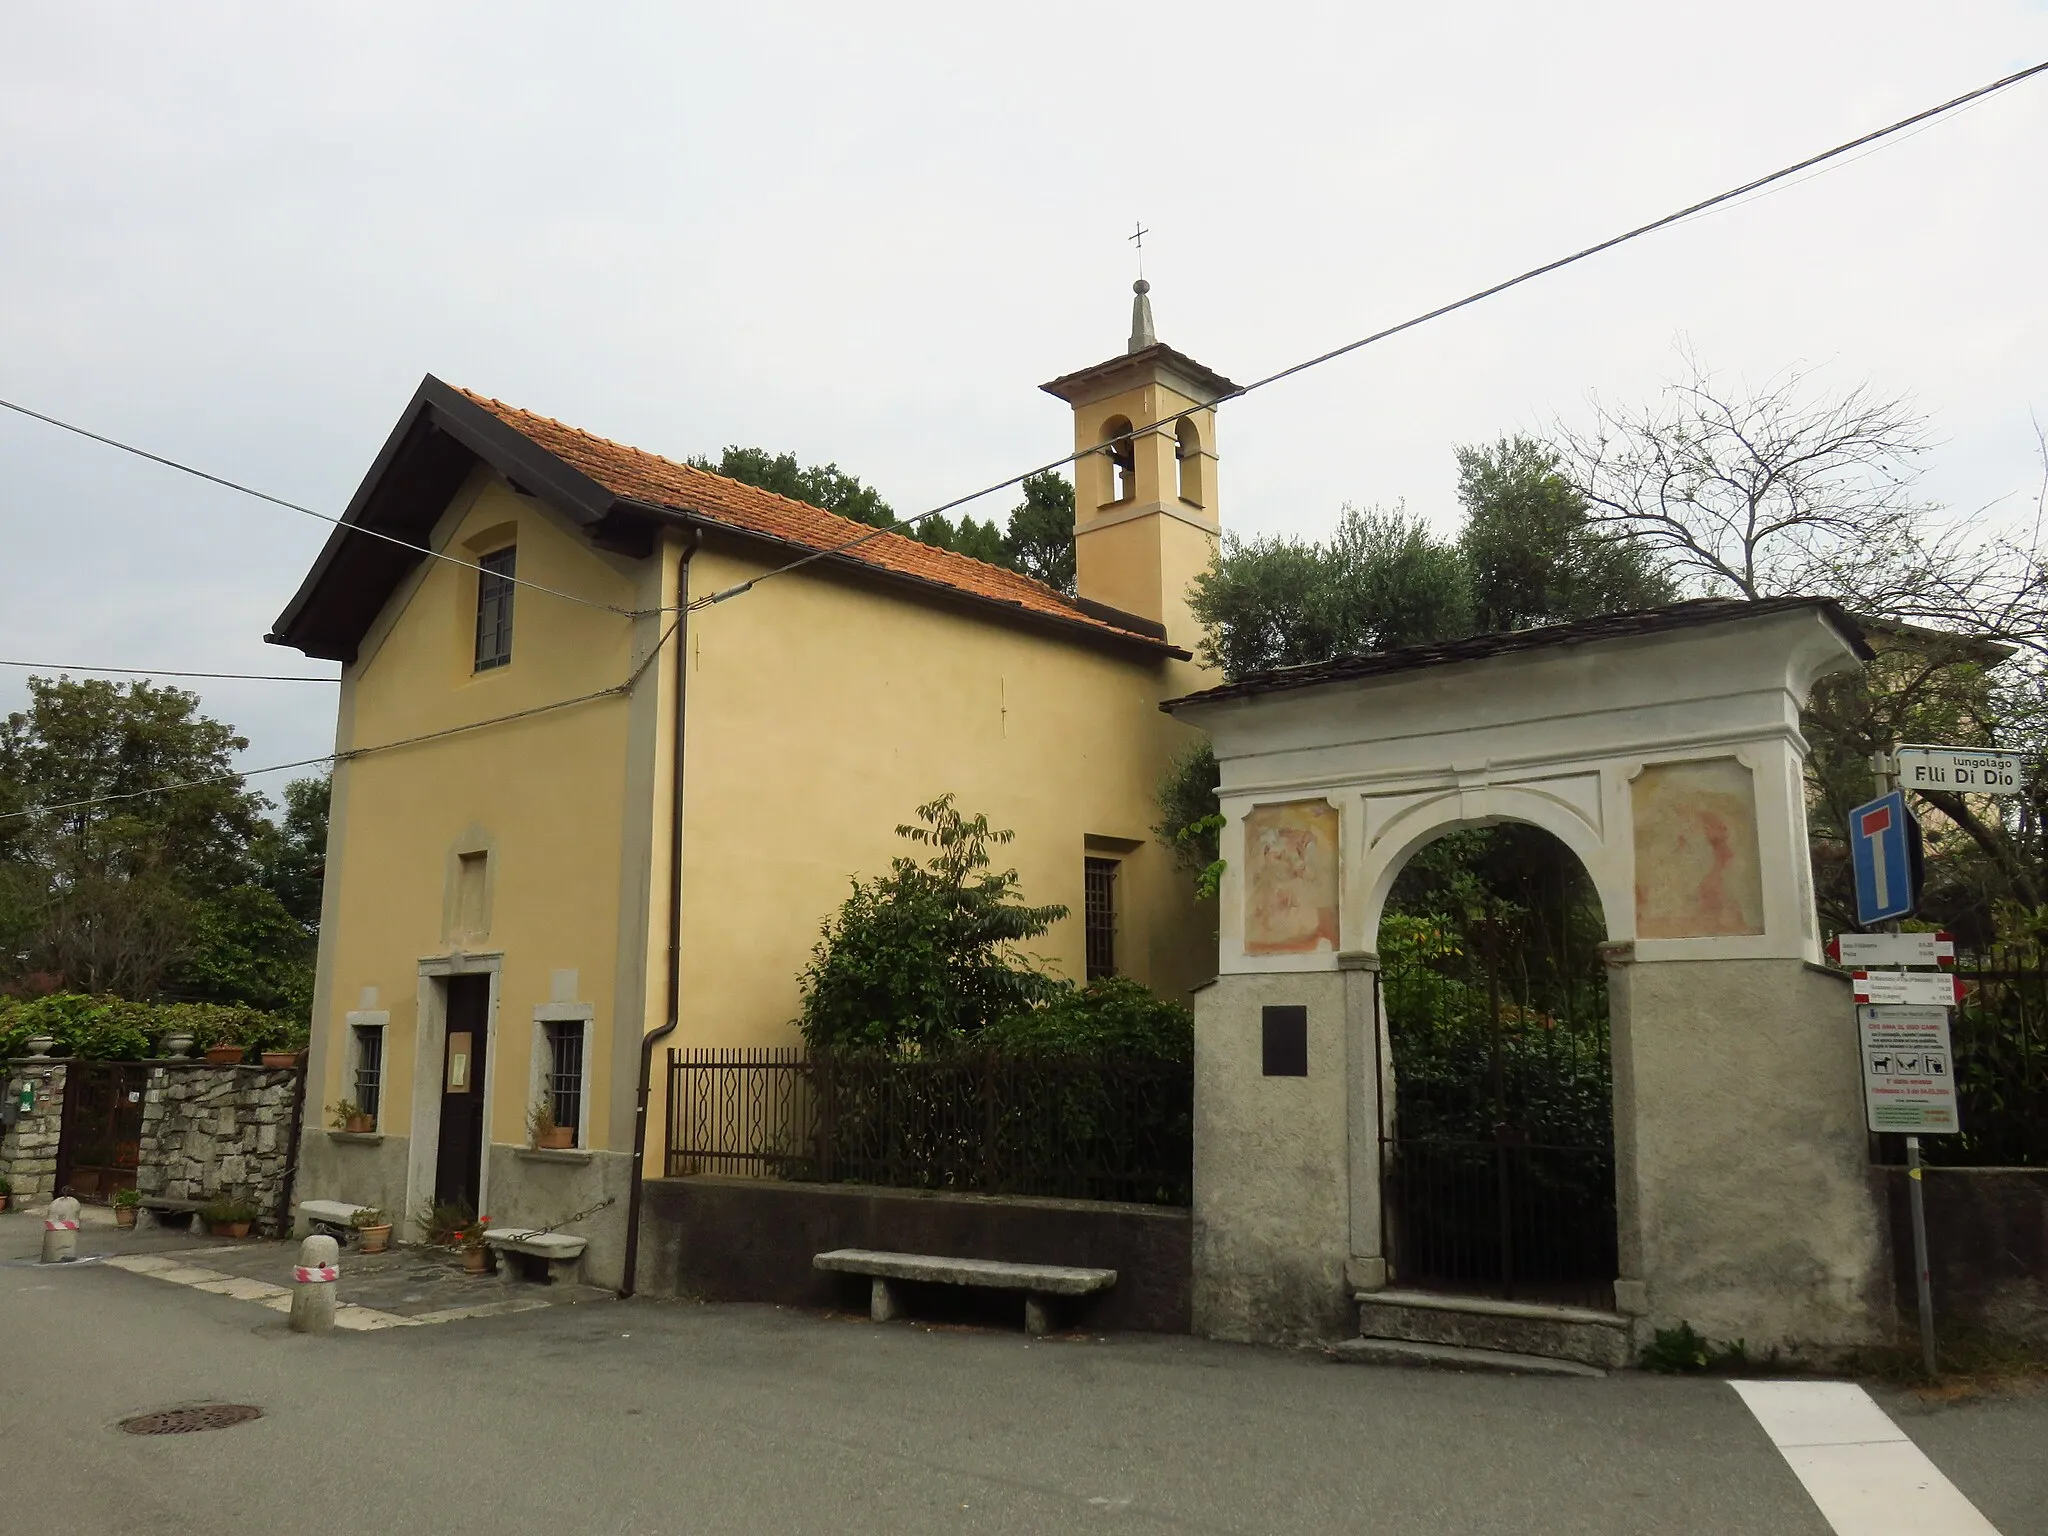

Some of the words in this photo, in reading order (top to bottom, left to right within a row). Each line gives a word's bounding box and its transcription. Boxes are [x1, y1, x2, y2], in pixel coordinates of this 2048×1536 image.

[1953, 756, 2012, 769] lungolago
[1915, 766, 1945, 782] F.lli
[1954, 769, 1975, 784] Di
[1984, 769, 2013, 785] Dio
